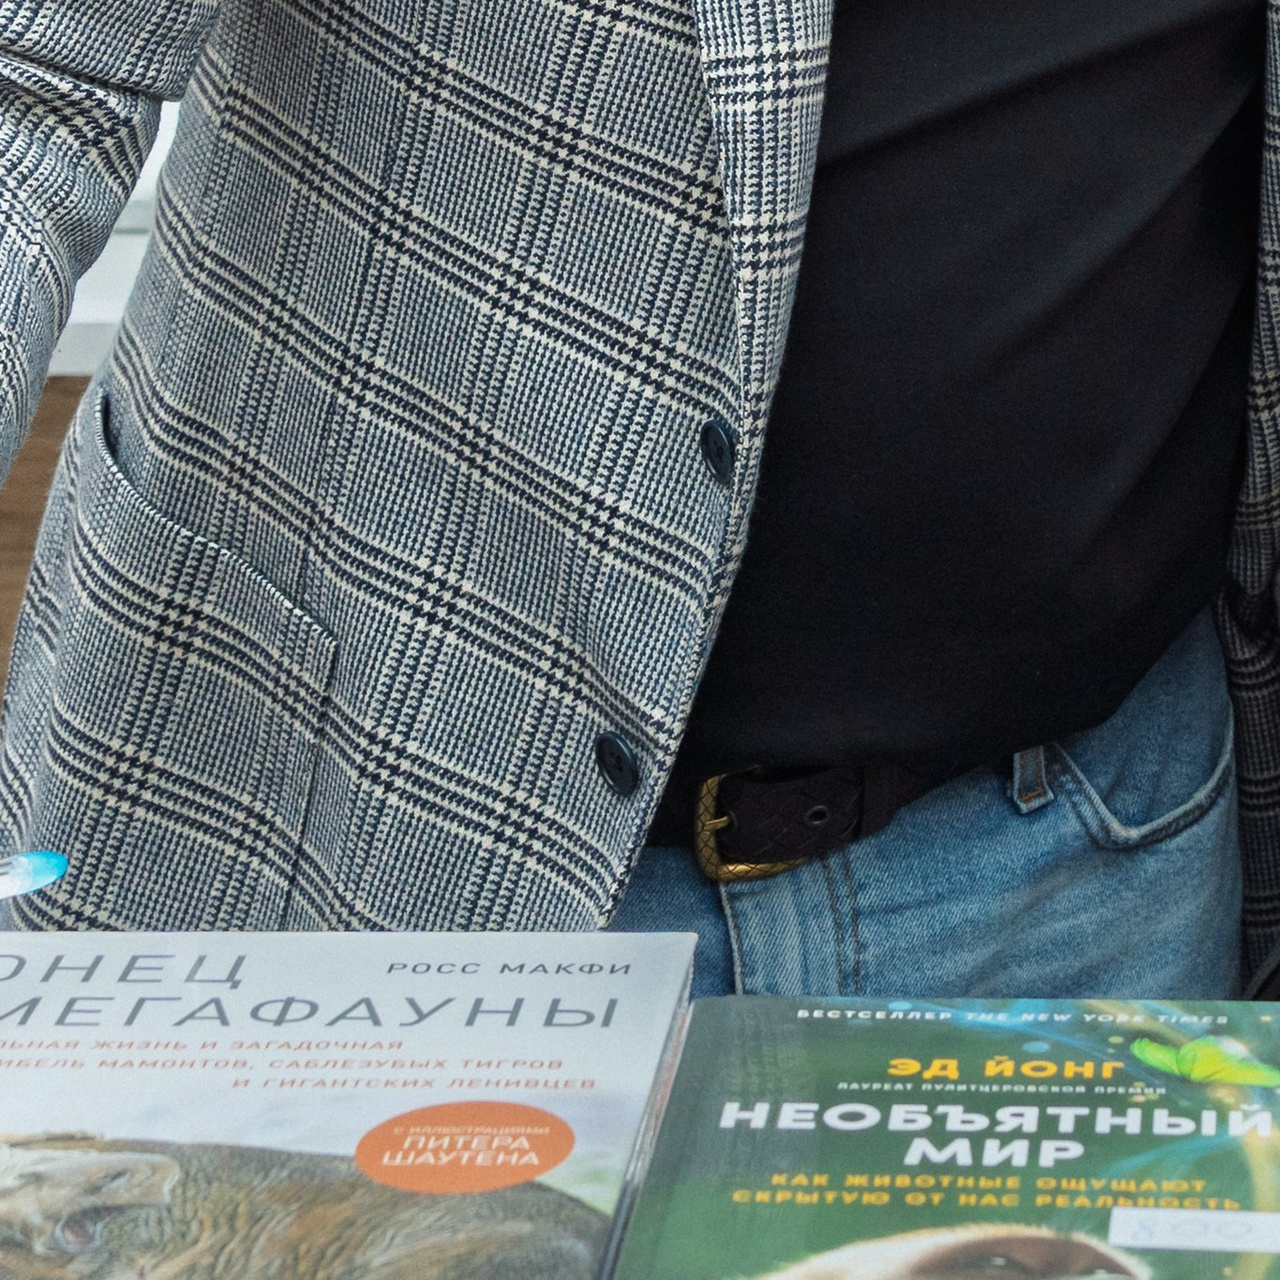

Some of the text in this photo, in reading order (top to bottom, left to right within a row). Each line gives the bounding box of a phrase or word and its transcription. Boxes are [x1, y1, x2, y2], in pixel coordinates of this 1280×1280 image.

[386, 962, 632, 975] РОСС МАКФИ
[796, 1008, 952, 1020] БЕСТСЕЛЛЕР
[1020, 1012, 1072, 1023] NEW
[1082, 1013, 1145, 1025] YORK
[1156, 1014, 1229, 1025] TIMES
[91, 1040, 188, 1050] ЖИЗНЬ
[200, 1041, 218, 1050] И
[230, 1040, 404, 1051] ЗАГАДОЧНАЯ
[98, 1059, 254, 1070] МАМОНТОВ,
[268, 1059, 448, 1070] САБЛЕЗУБЫХ
[461, 1059, 563, 1070] ТИГРОВ
[887, 1055, 1125, 1080] ЭД ЙОНГ
[231, 1078, 597, 1090] И ГИГАНТСКИХ ЛЕНИВЦЕВ
[836, 1081, 914, 1091] ЛАУРЕАТ
[718, 1101, 1273, 1138] НЕОБЪЯТНЫЙ
[402, 1134, 531, 1151] ПИТЕРА
[381, 1150, 540, 1167] ШАУТЕНА
[902, 1137, 1086, 1168] МИР
[770, 1172, 1206, 1193] КАК ЖИВОТНЫЕ ОЩУЩАЮТ
[731, 1189, 1242, 1212] СКРЫТУЮ ОТ НАС РЕАЛЬНОСТЬ
